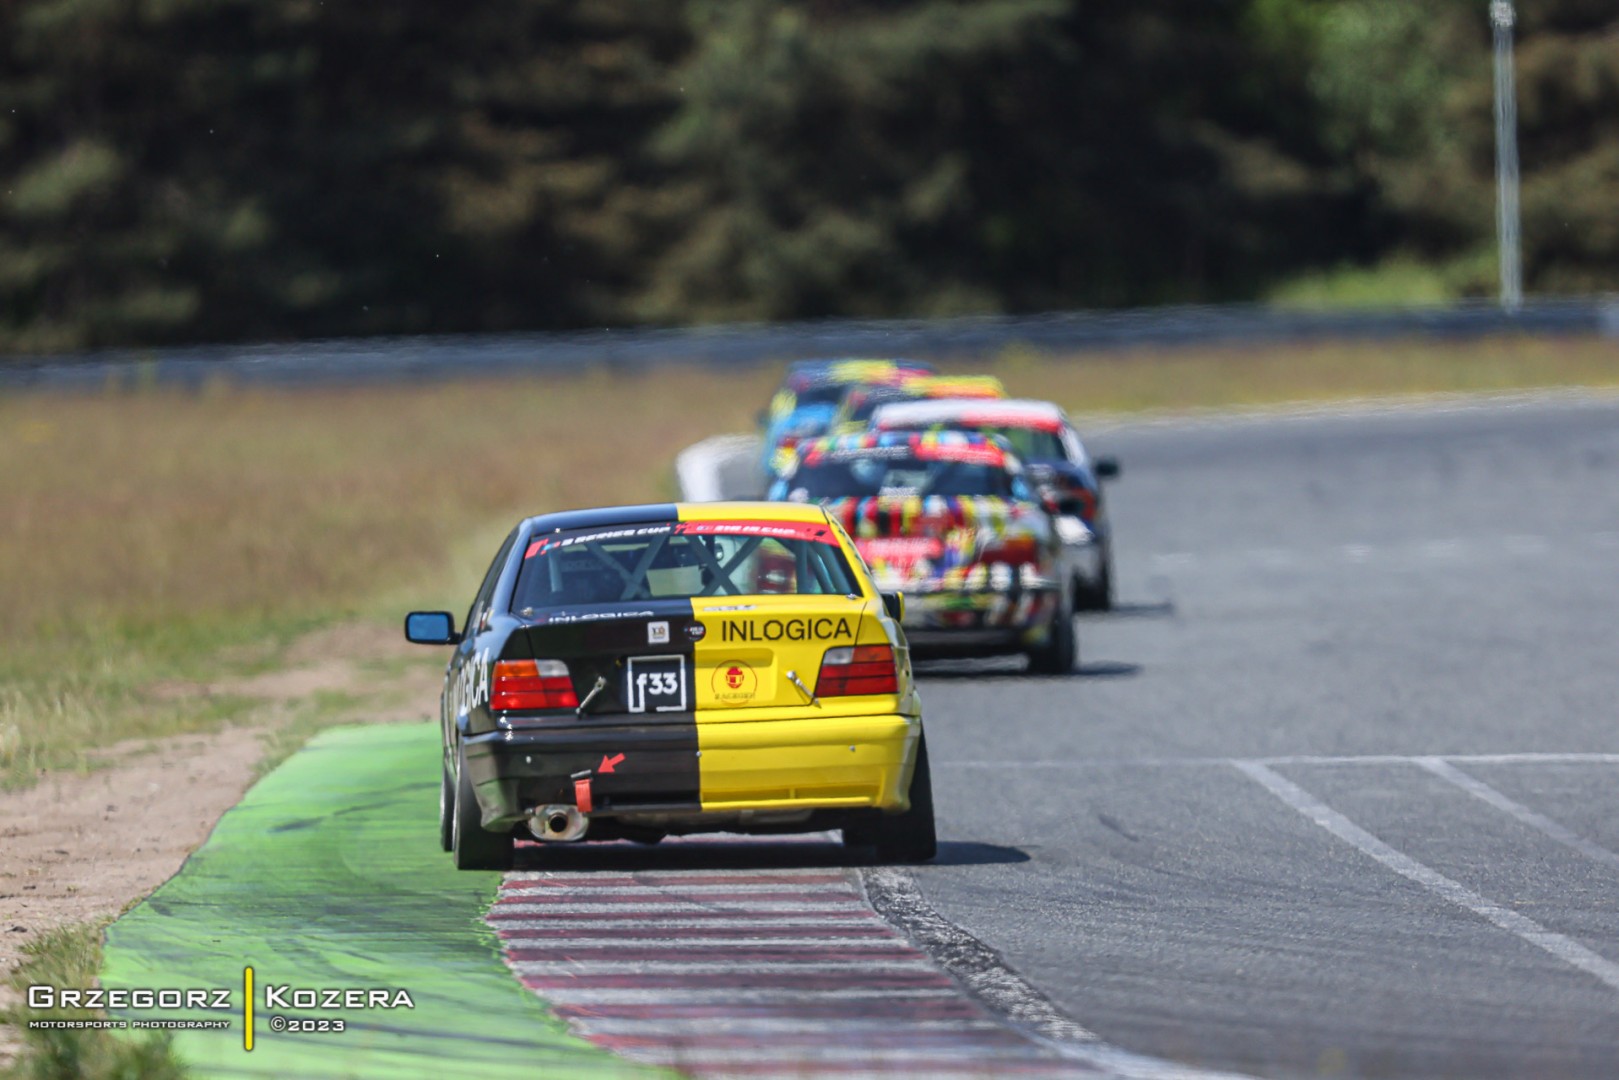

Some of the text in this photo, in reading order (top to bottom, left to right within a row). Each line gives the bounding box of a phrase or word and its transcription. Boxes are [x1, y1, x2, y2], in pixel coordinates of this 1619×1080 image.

[636, 526, 671, 536] CUP
[722, 617, 852, 642] INLOGICA
[636, 672, 678, 706] f33
